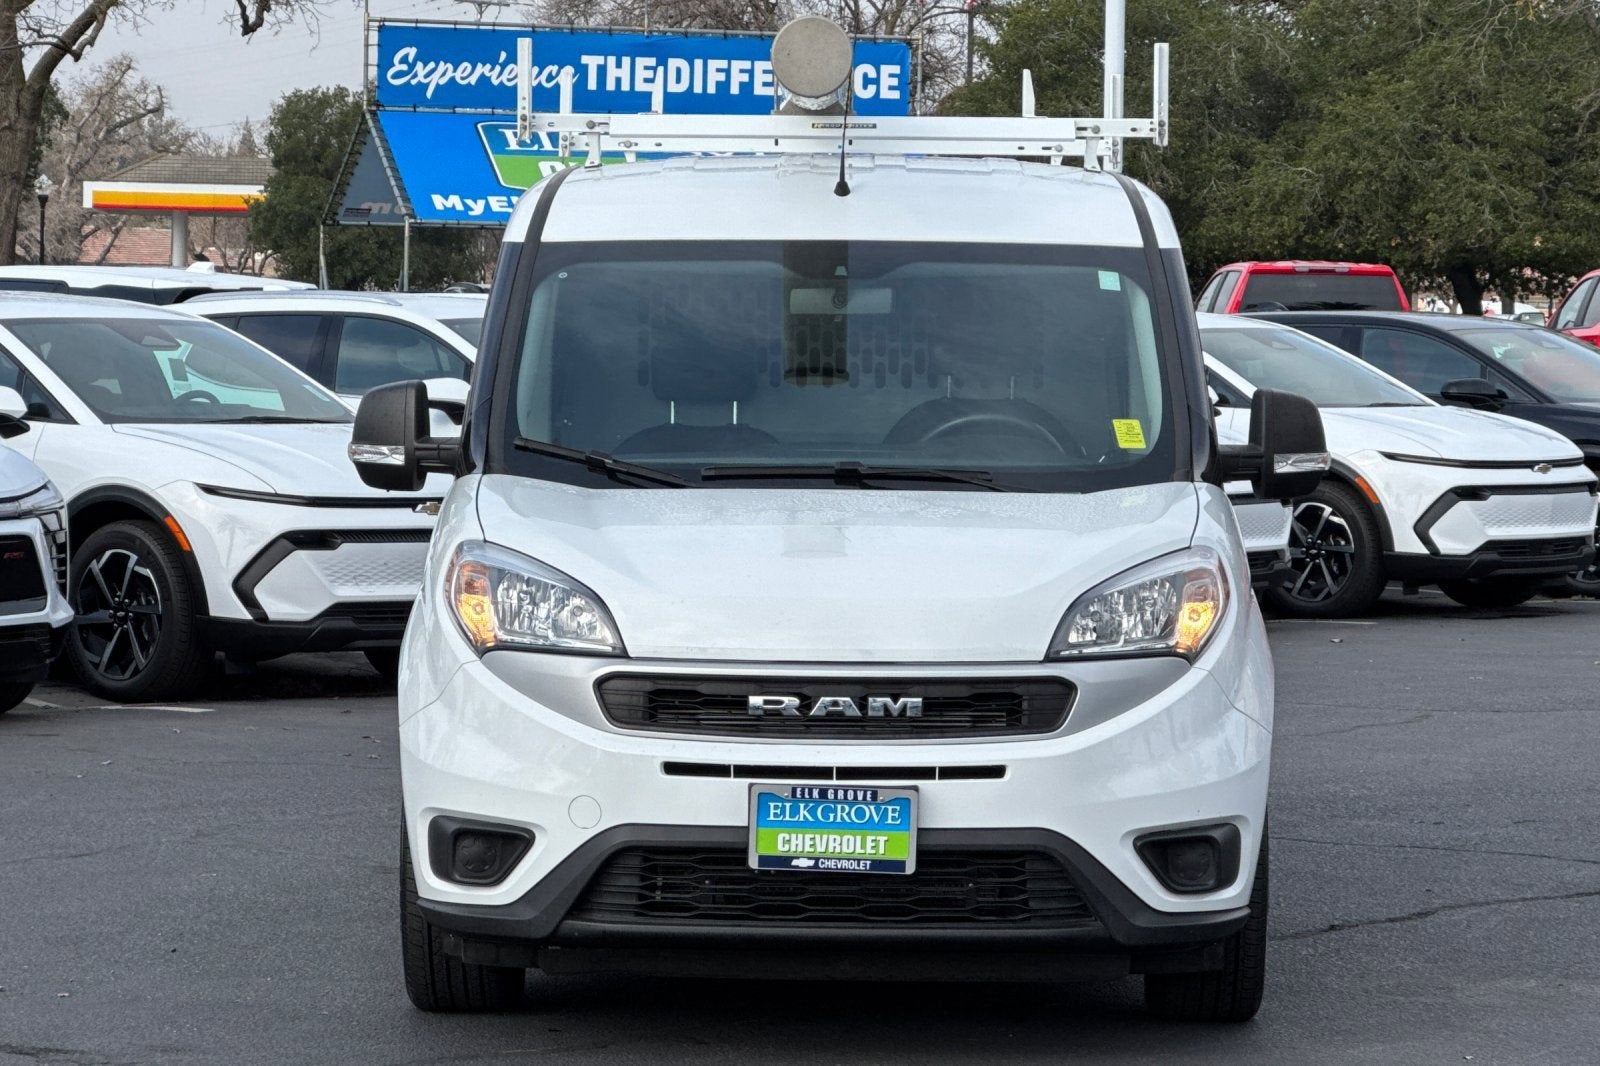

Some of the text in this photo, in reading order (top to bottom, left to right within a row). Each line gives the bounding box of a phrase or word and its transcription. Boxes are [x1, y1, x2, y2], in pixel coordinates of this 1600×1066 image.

[581, 55, 657, 92] THE
[667, 57, 901, 99] DIFFECE
[748, 695, 923, 717] RAM
[796, 789, 873, 802] ELK GROVE
[766, 802, 902, 825] ELK GROVE
[777, 832, 889, 855] CHEVROLET
[818, 858, 872, 871] CHEVROLET
